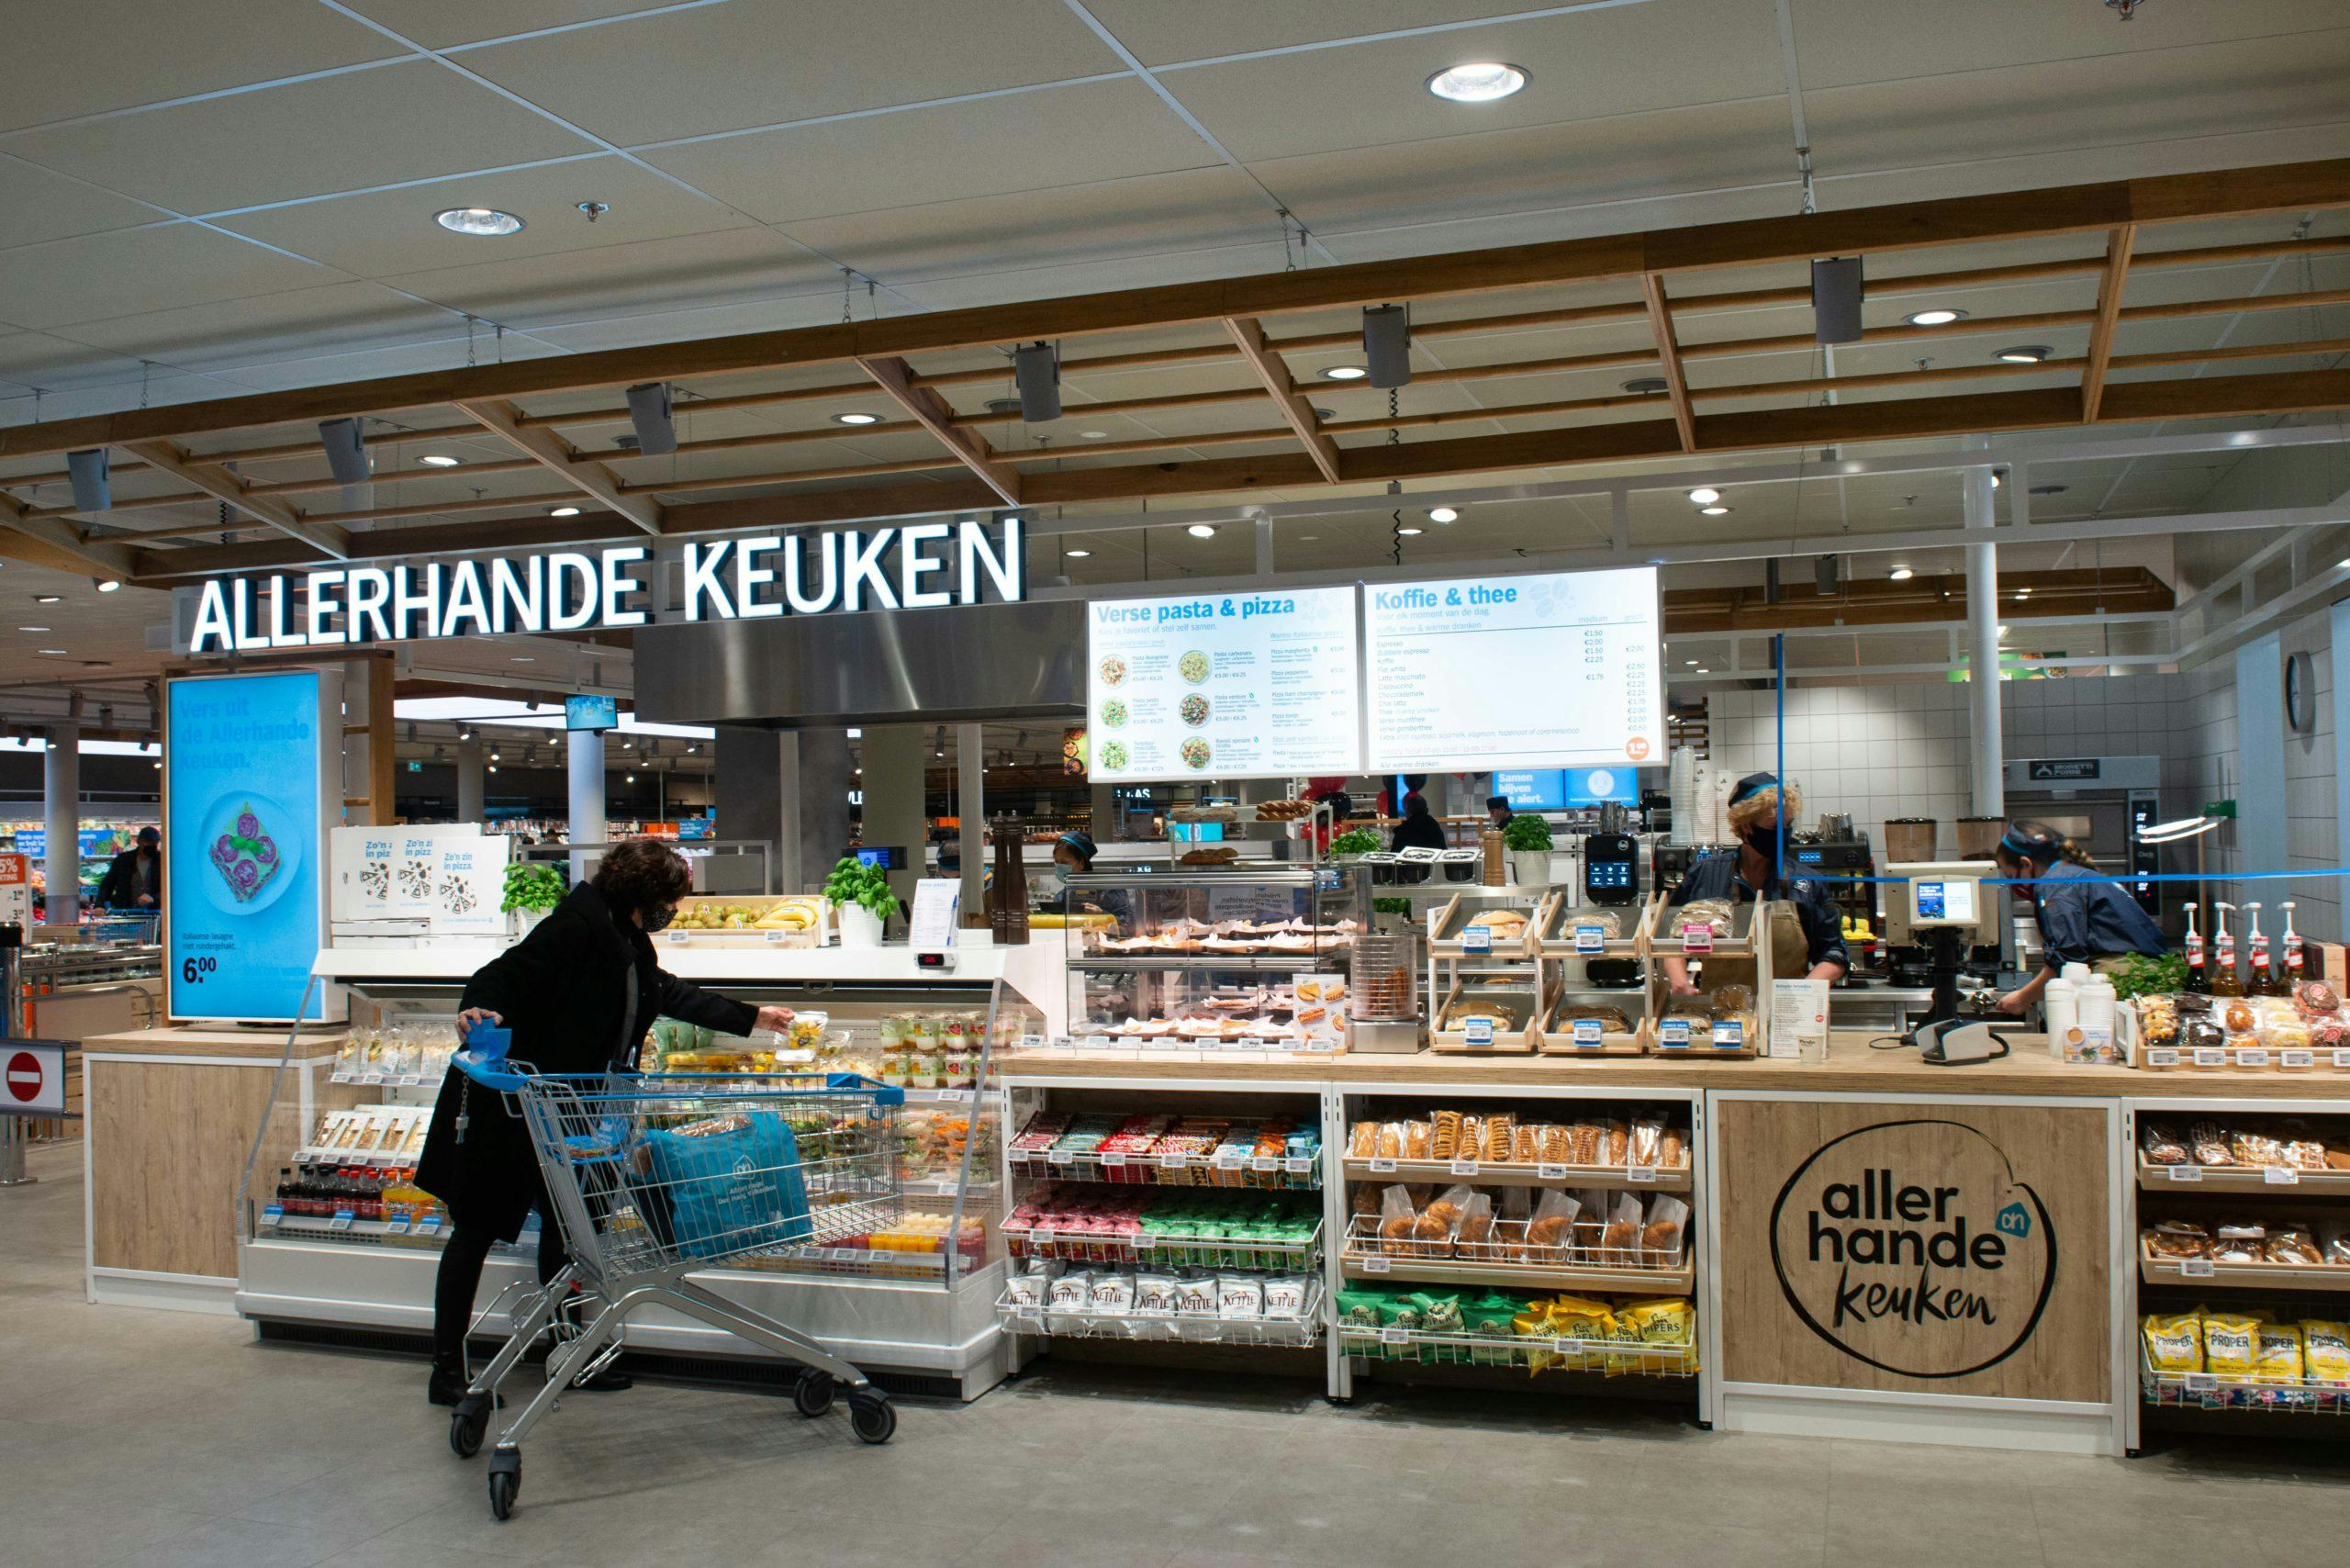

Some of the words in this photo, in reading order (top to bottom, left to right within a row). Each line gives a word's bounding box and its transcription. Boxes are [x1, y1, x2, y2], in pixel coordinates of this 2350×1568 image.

[190, 546, 650, 653] ALLERHANDE
[683, 517, 1023, 622] KEUKEN
[1375, 588, 1438, 610] Koffie
[1445, 587, 1461, 607] &
[1469, 584, 1517, 605] thee
[1097, 606, 1151, 623] Verse
[1158, 600, 1213, 623] pasta
[1220, 599, 1236, 617] &
[1241, 596, 1294, 620] pizza
[1410, 610, 1443, 619] moment
[1461, 608, 1472, 616] de
[1452, 622, 1482, 630] dranken
[179, 700, 219, 719] Vers
[225, 695, 251, 717] uit
[182, 722, 203, 745] de
[210, 717, 310, 744] Allerhande
[180, 748, 251, 770] keuken.
[1498, 773, 1533, 783] Samen
[1498, 783, 1531, 794] blijven
[1516, 793, 1543, 803] alert.
[365, 841, 386, 849] Zo'n
[406, 839, 424, 847] Zo'n
[365, 849, 375, 858] in
[405, 847, 413, 856] in
[444, 852, 460, 861] Zo'n
[462, 852, 473, 860] zin
[443, 862, 451, 870] in
[1821, 1169, 1960, 1223] aller
[1807, 1210, 2007, 1271] hande
[1050, 1287, 1080, 1303] KETTLE
[1091, 1286, 1125, 1302] KETTLE
[1139, 1293, 1169, 1309] KETTLE
[1224, 1290, 1258, 1305] KETTLE
[1832, 1259, 1997, 1329] keuken
[1181, 1294, 1213, 1310] KETTLE
[1344, 1317, 1380, 1327] PIPERS
[1643, 1324, 1681, 1336] PIPERS
[2155, 1334, 2193, 1348] PROPER
[2211, 1334, 2249, 1349] PROPER
